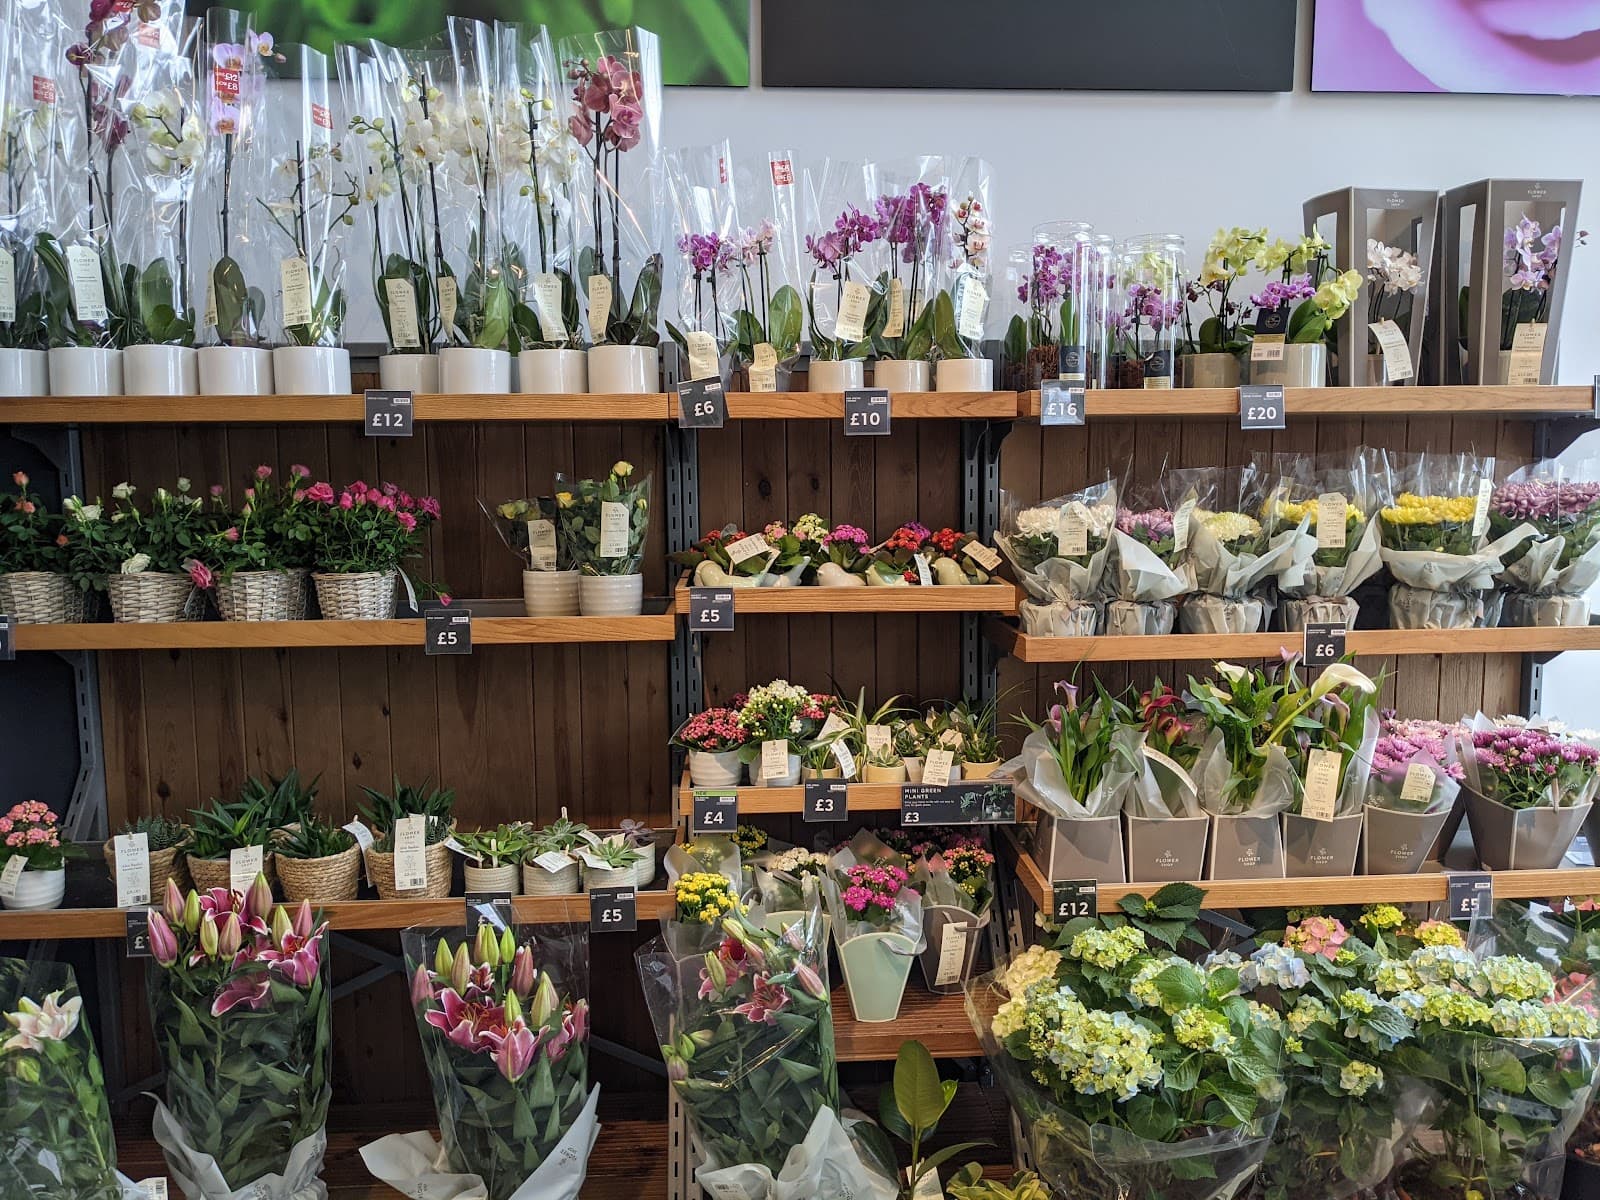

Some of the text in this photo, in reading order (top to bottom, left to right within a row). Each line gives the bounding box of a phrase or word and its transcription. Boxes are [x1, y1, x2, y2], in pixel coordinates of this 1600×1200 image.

[227, 83, 238, 91] £8
[694, 400, 714, 417] £6
[1048, 402, 1077, 416] £16
[1248, 407, 1277, 420] £20
[372, 413, 403, 427] £12
[850, 412, 880, 426] £10
[700, 609, 720, 623] £5
[437, 631, 457, 645] £5
[1315, 644, 1334, 657] £6
[814, 798, 834, 812] £3
[703, 811, 724, 825] £4
[904, 812, 920, 823] £3
[1058, 901, 1089, 916] £12
[1460, 897, 1480, 912] £5
[601, 908, 622, 923] £5
